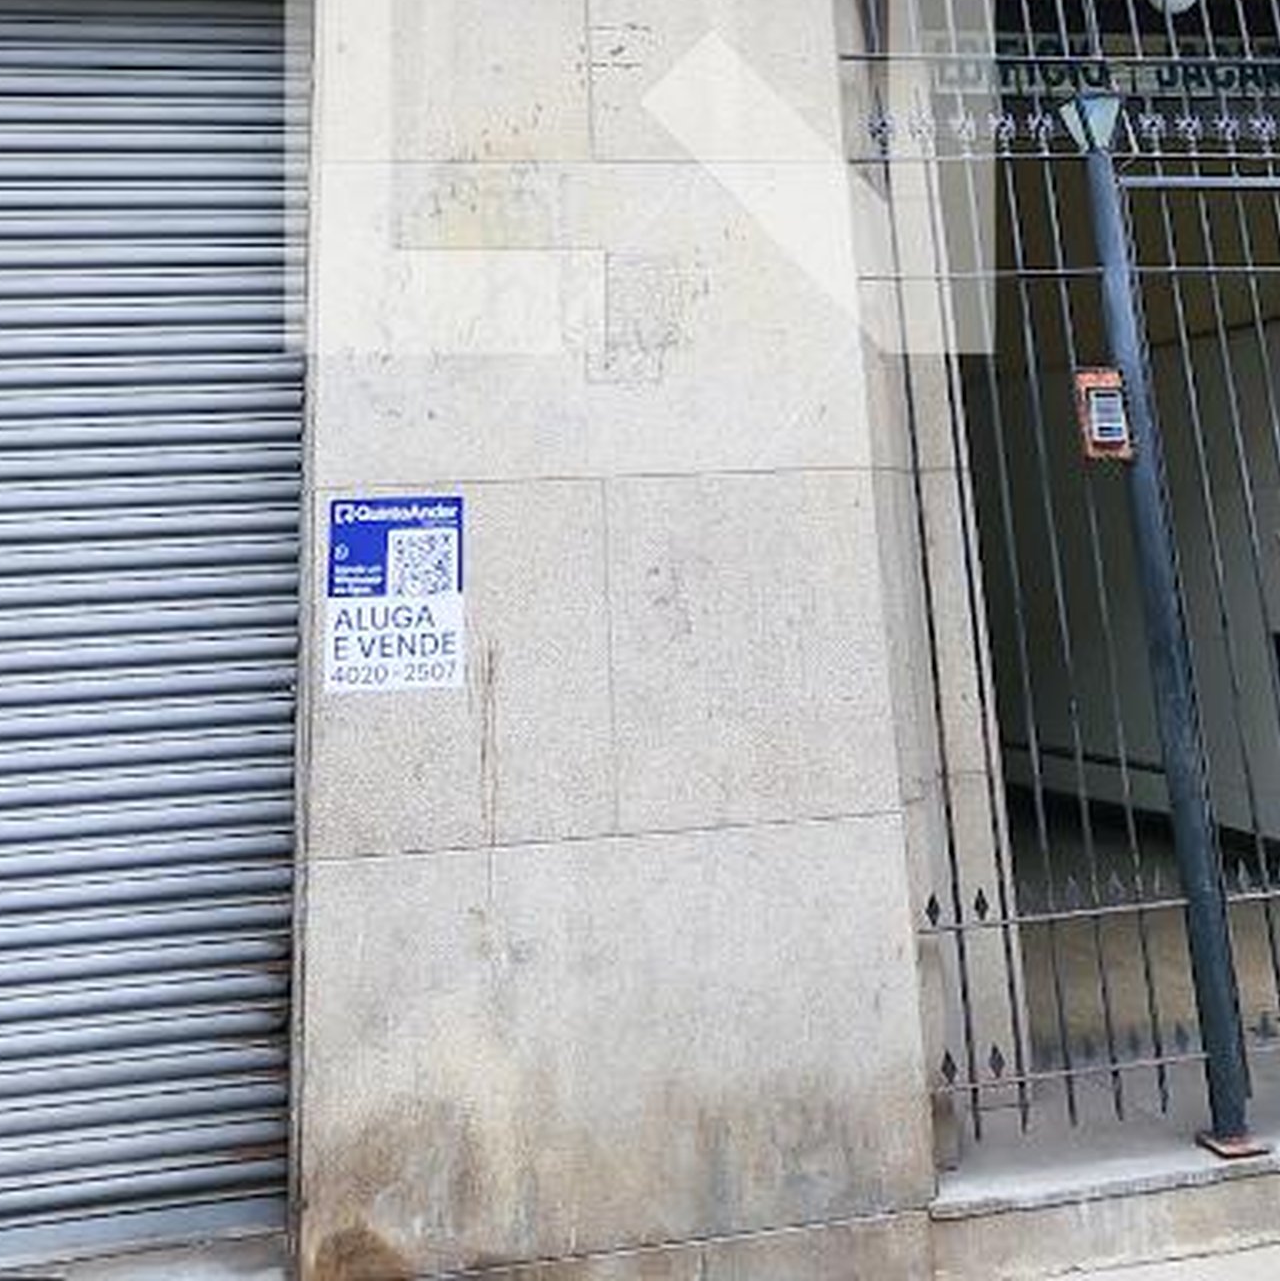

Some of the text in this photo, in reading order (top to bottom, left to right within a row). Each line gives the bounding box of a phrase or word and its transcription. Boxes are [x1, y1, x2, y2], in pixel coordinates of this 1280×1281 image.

[333, 605, 435, 631] ALUGA
[334, 632, 456, 661] E VENDE
